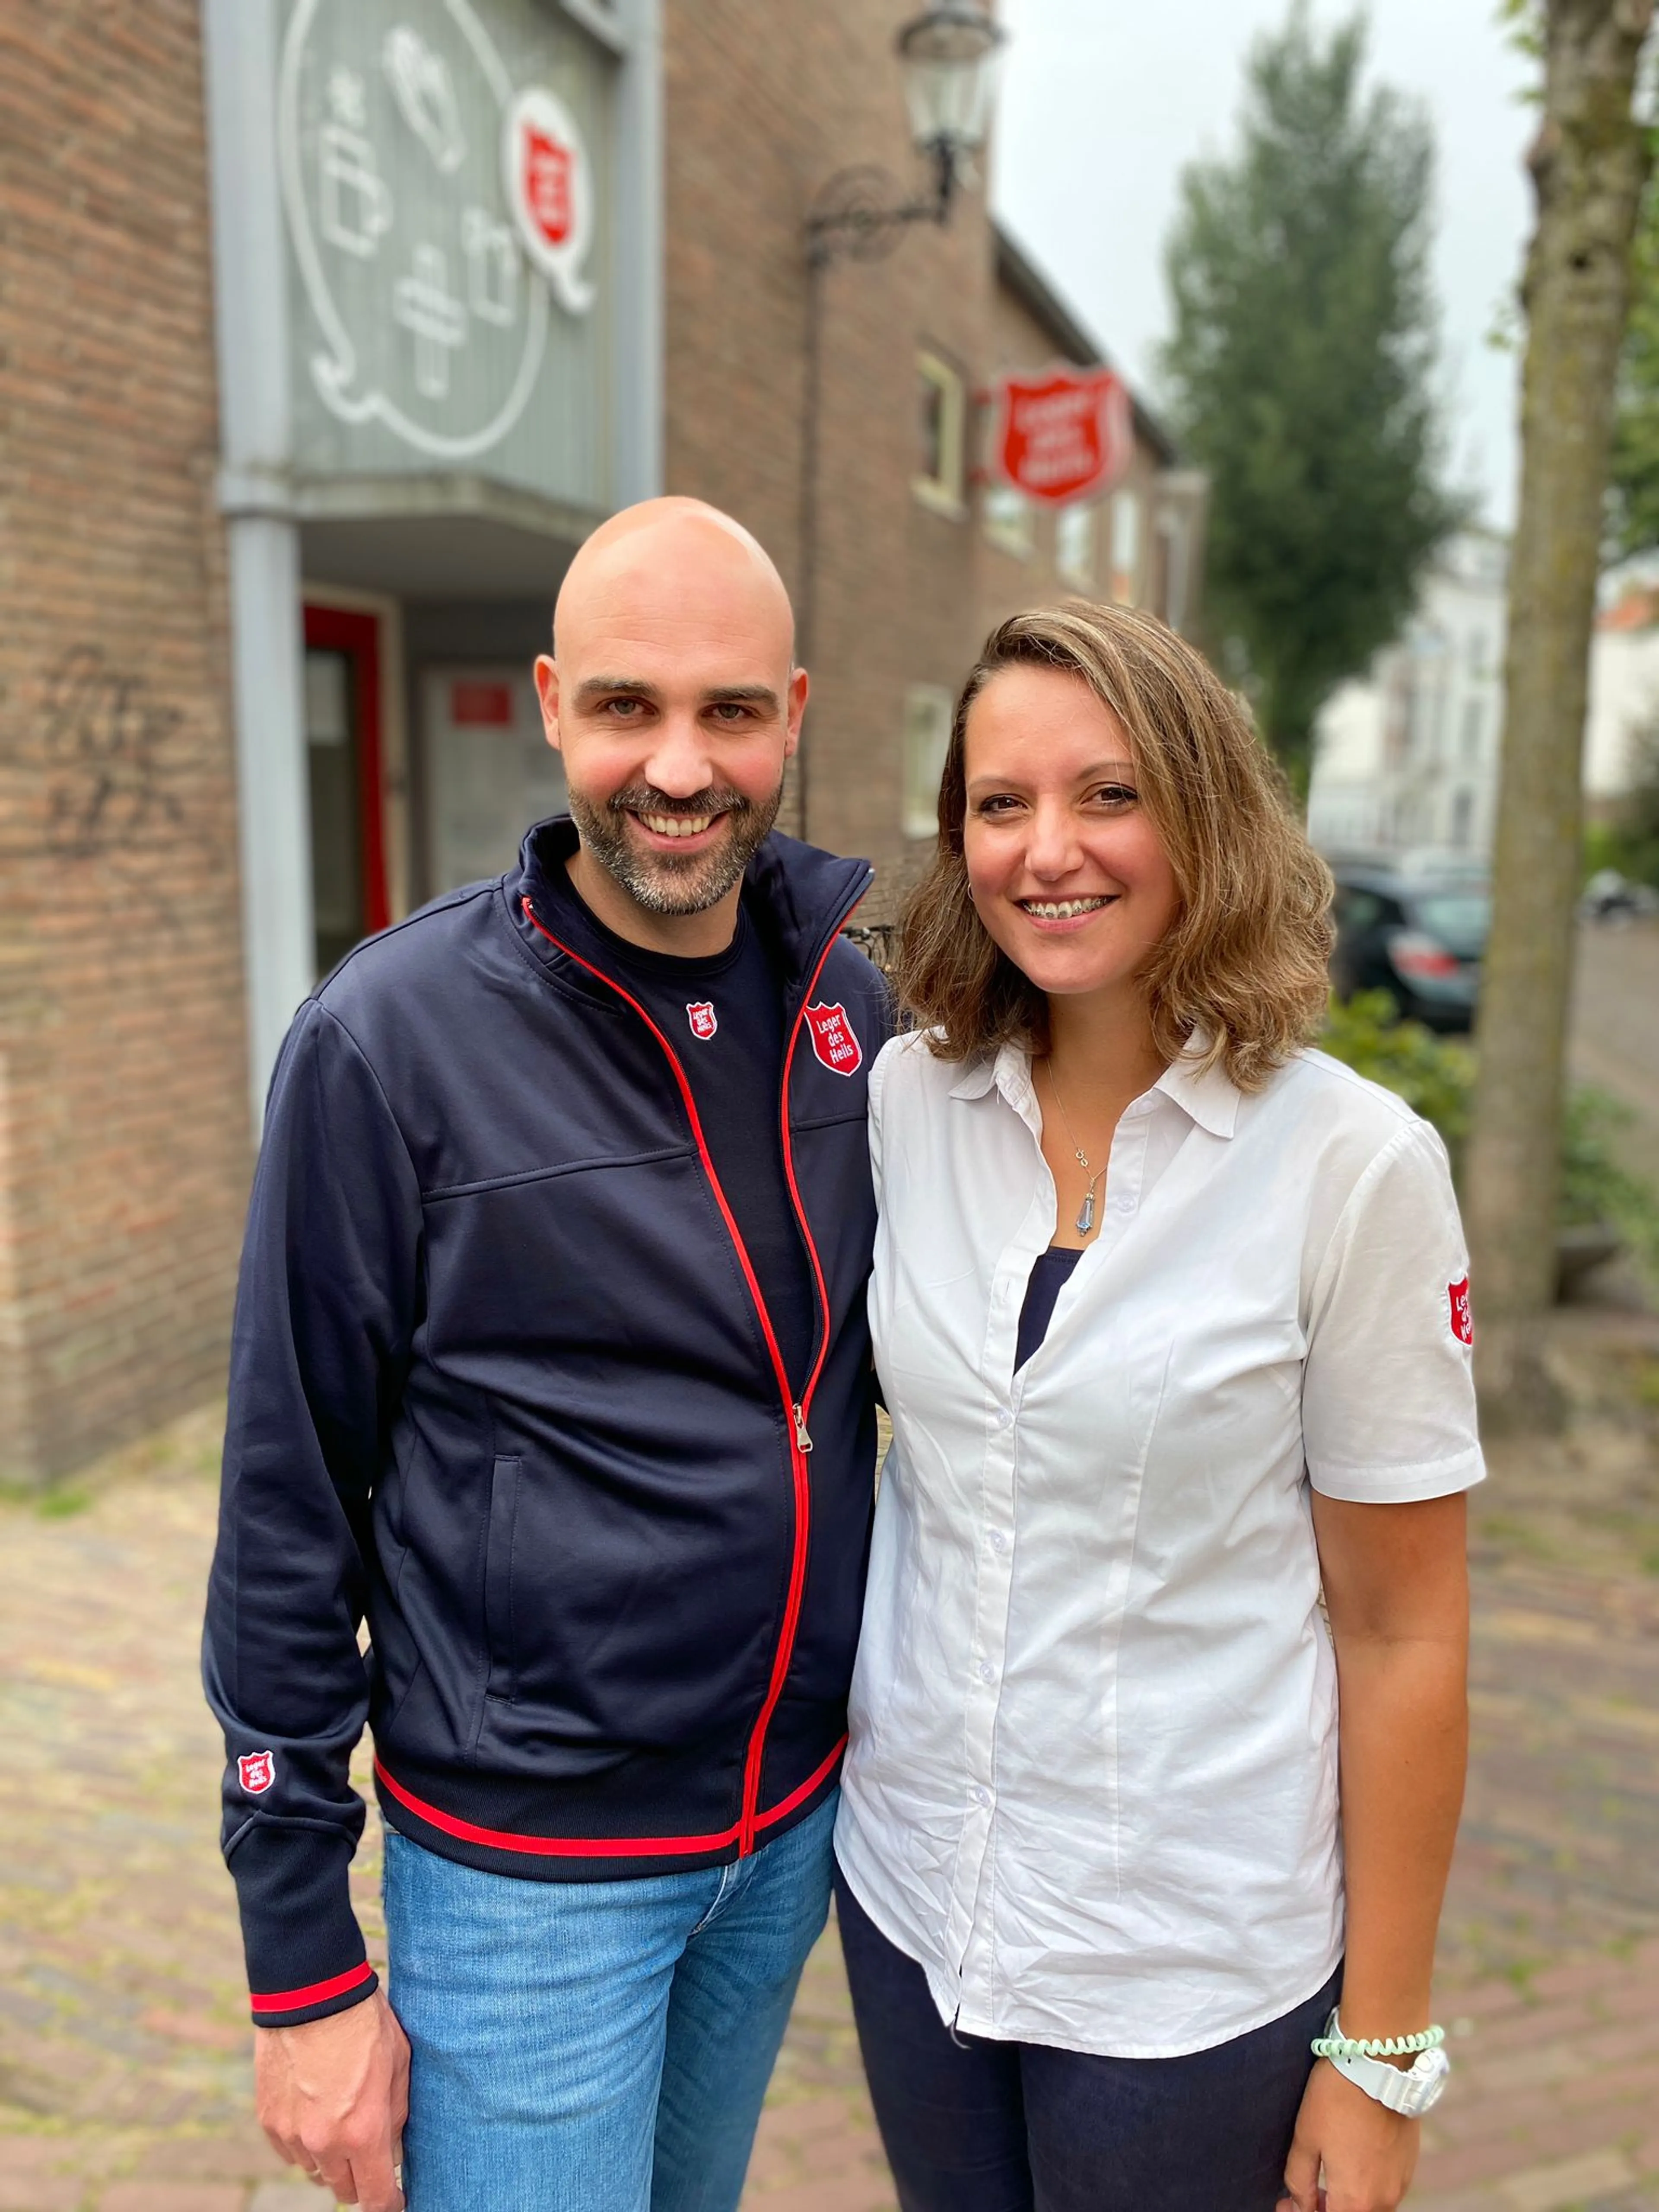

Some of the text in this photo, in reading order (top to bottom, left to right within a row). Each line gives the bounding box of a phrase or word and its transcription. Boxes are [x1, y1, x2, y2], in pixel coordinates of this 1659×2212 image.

[816, 1014, 841, 1034] Leger
[828, 1031, 844, 1046] des
[829, 1043, 854, 1064] Heils
